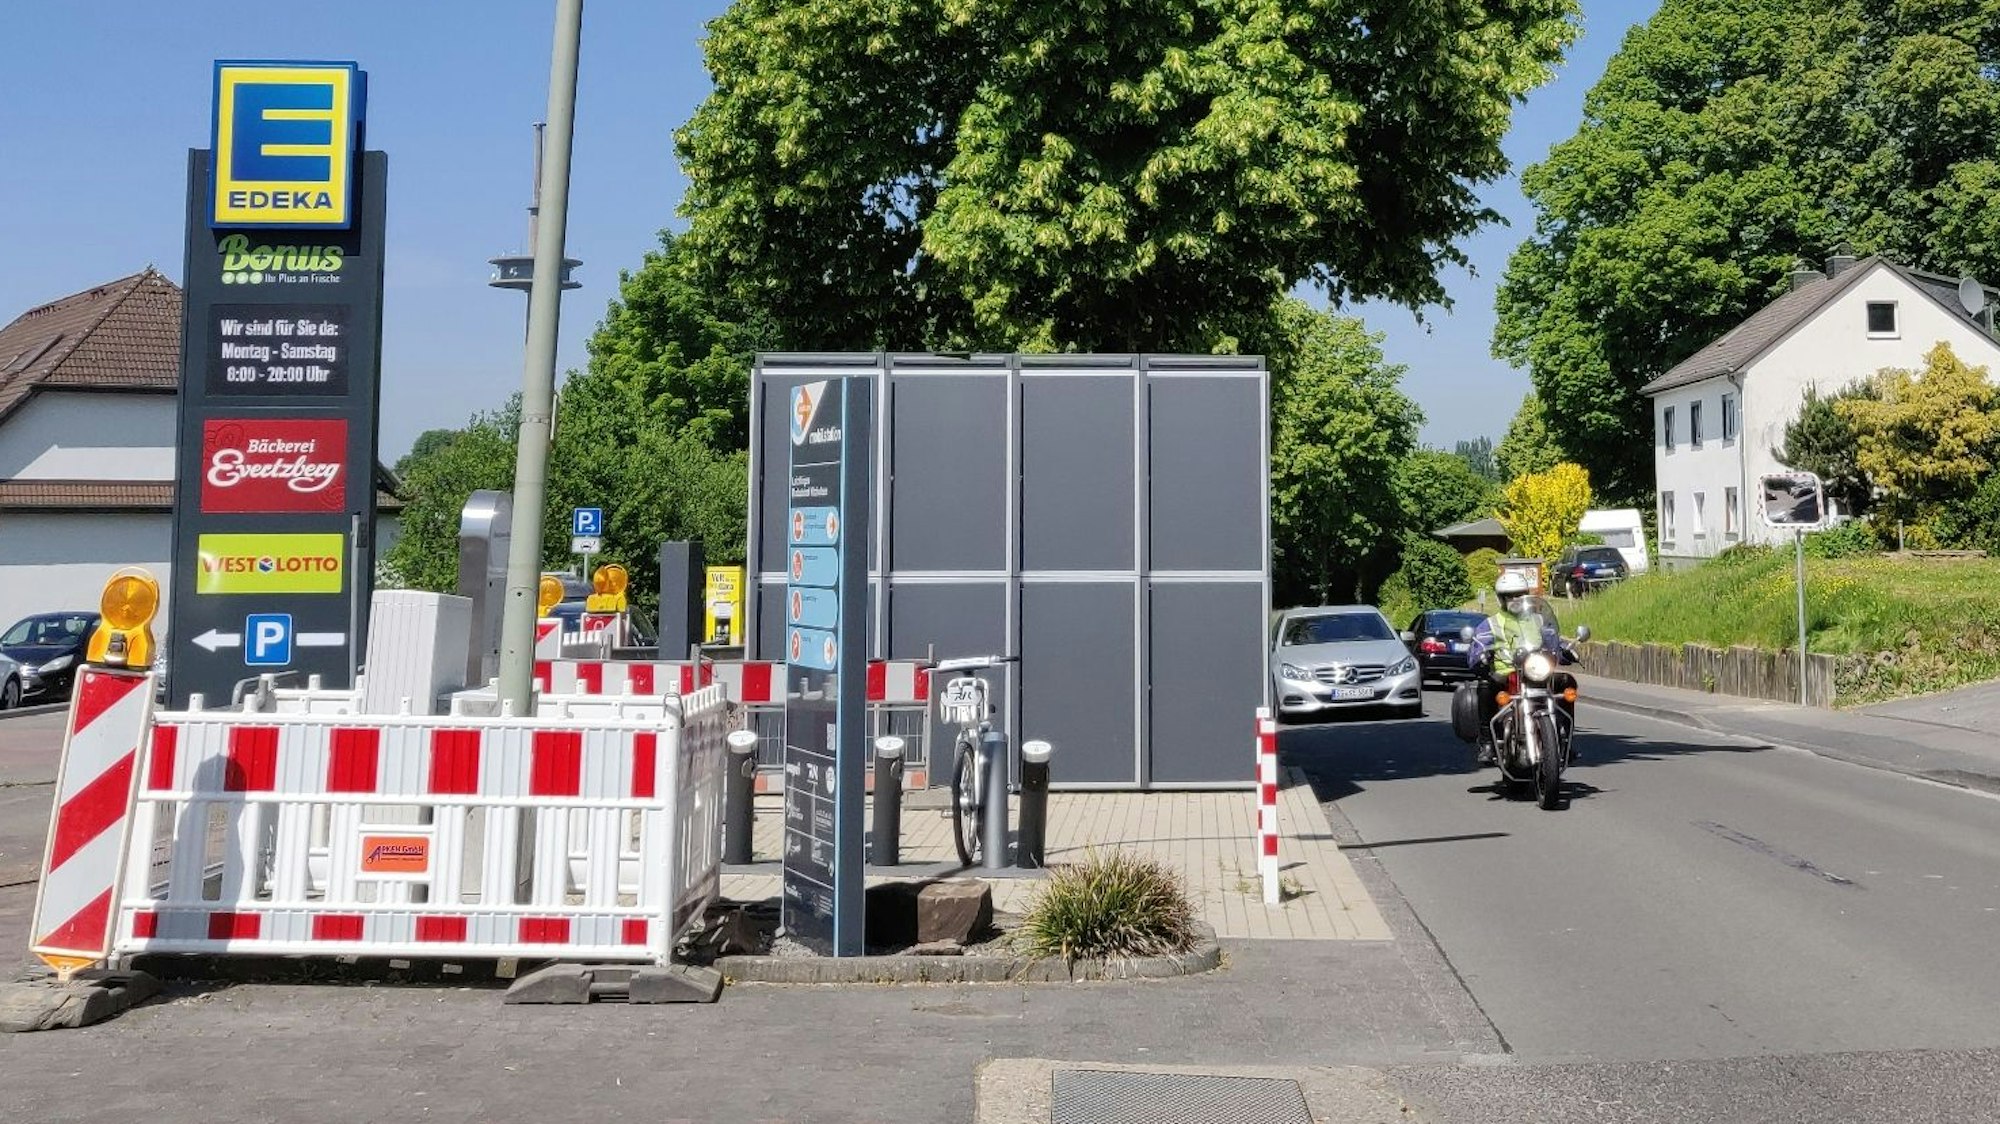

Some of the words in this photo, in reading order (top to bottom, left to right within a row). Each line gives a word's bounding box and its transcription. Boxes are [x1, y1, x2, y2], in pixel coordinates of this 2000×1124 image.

[228, 191, 333, 209] EDEKA
[218, 233, 344, 271] Bonus
[264, 273, 276, 283] Ihr
[278, 273, 297, 283] Plus
[299, 275, 309, 283] an
[311, 273, 341, 283] Frische
[220, 319, 243, 336] Wir
[245, 319, 273, 336] sind
[275, 319, 295, 336] für
[297, 319, 317, 336] Sie
[319, 319, 339, 336] da:
[221, 342, 270, 362] Montag
[281, 342, 337, 362] Samstag
[226, 366, 256, 382] 8:00
[266, 366, 304, 382] 20:00
[305, 366, 331, 382] Uhr
[246, 438, 316, 454] Bäckerei
[206, 448, 341, 492] Evertzberg
[578, 511, 594, 532] P
[203, 556, 257, 573] WEST
[275, 556, 338, 573] LOTTO
[255, 621, 284, 657] P
